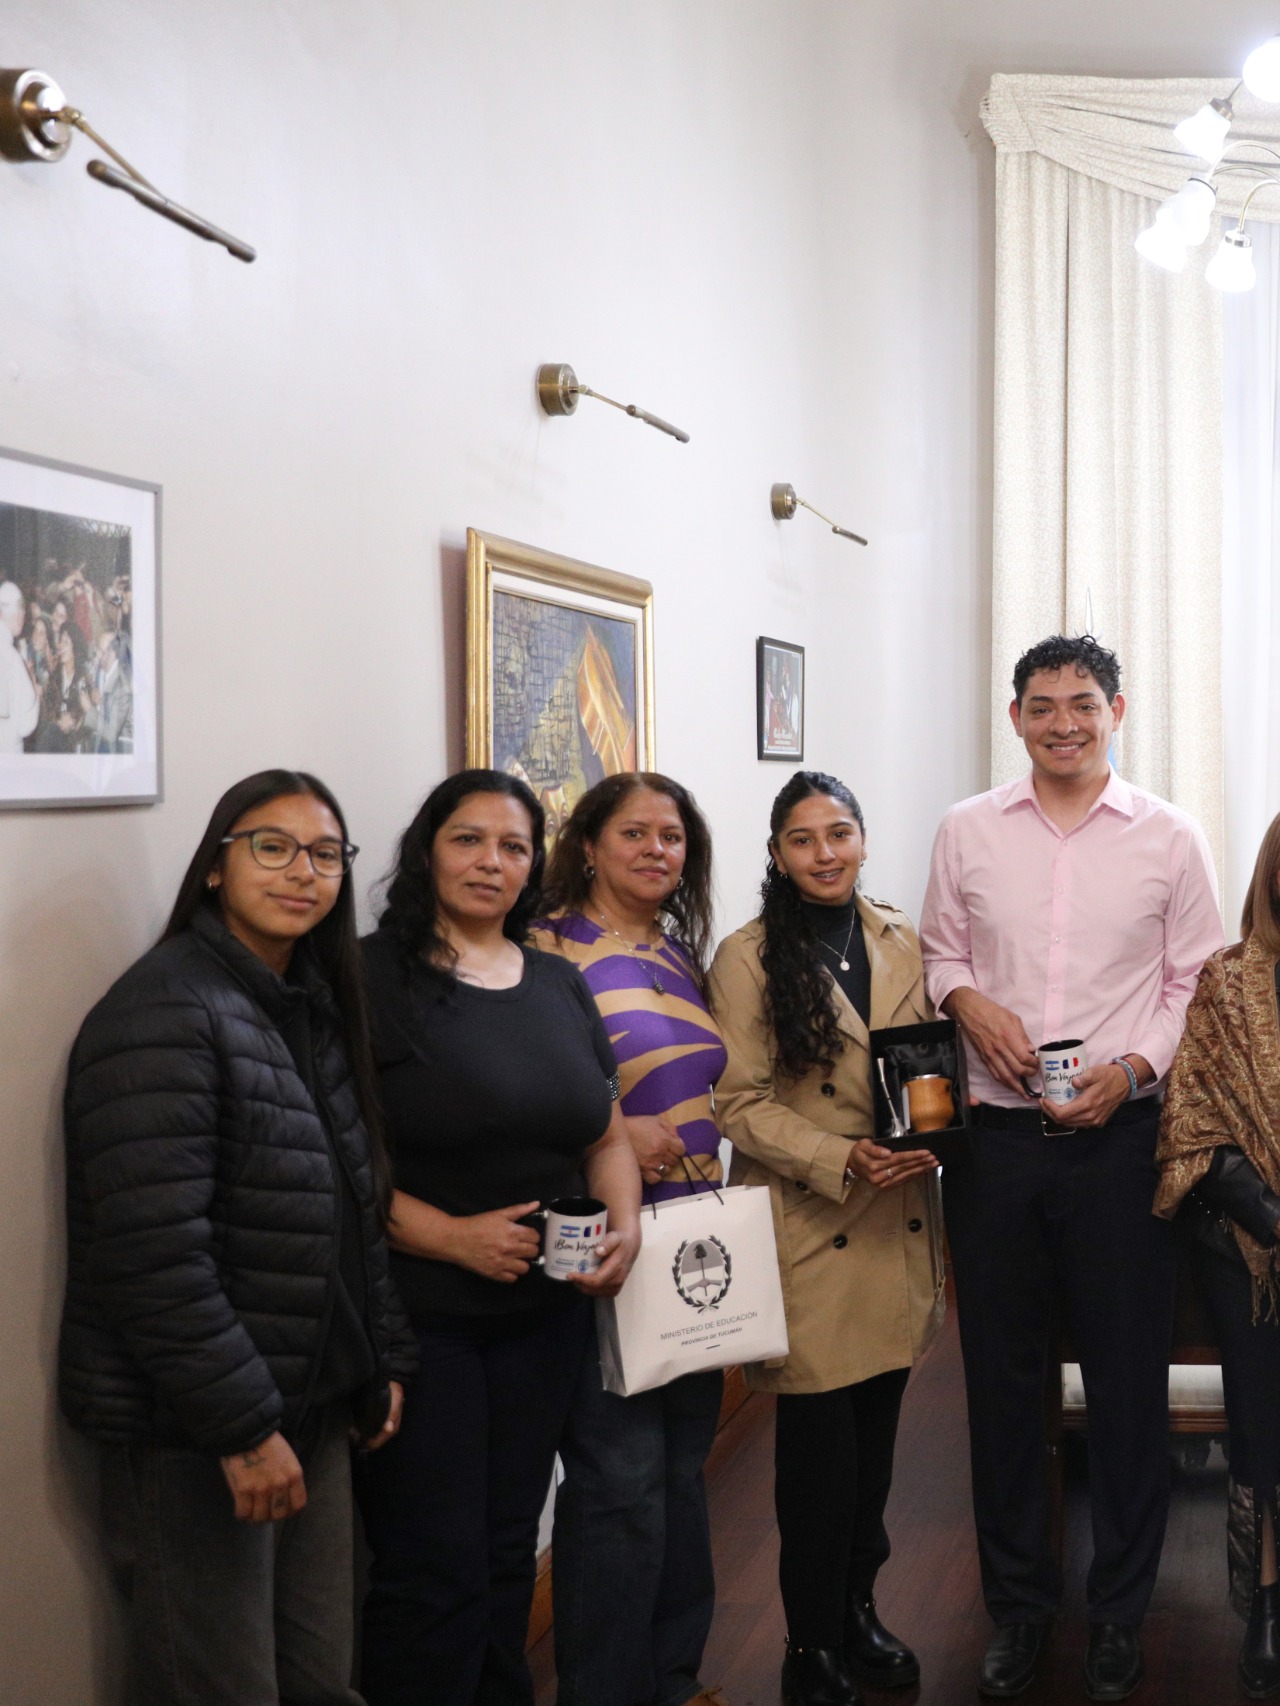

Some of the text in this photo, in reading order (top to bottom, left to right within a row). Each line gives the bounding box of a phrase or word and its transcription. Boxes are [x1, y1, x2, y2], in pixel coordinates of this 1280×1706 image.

[660, 1325, 703, 1340] MINISTERIO
[704, 1322, 715, 1330] DE
[681, 1335, 709, 1346] PROVINCIA
